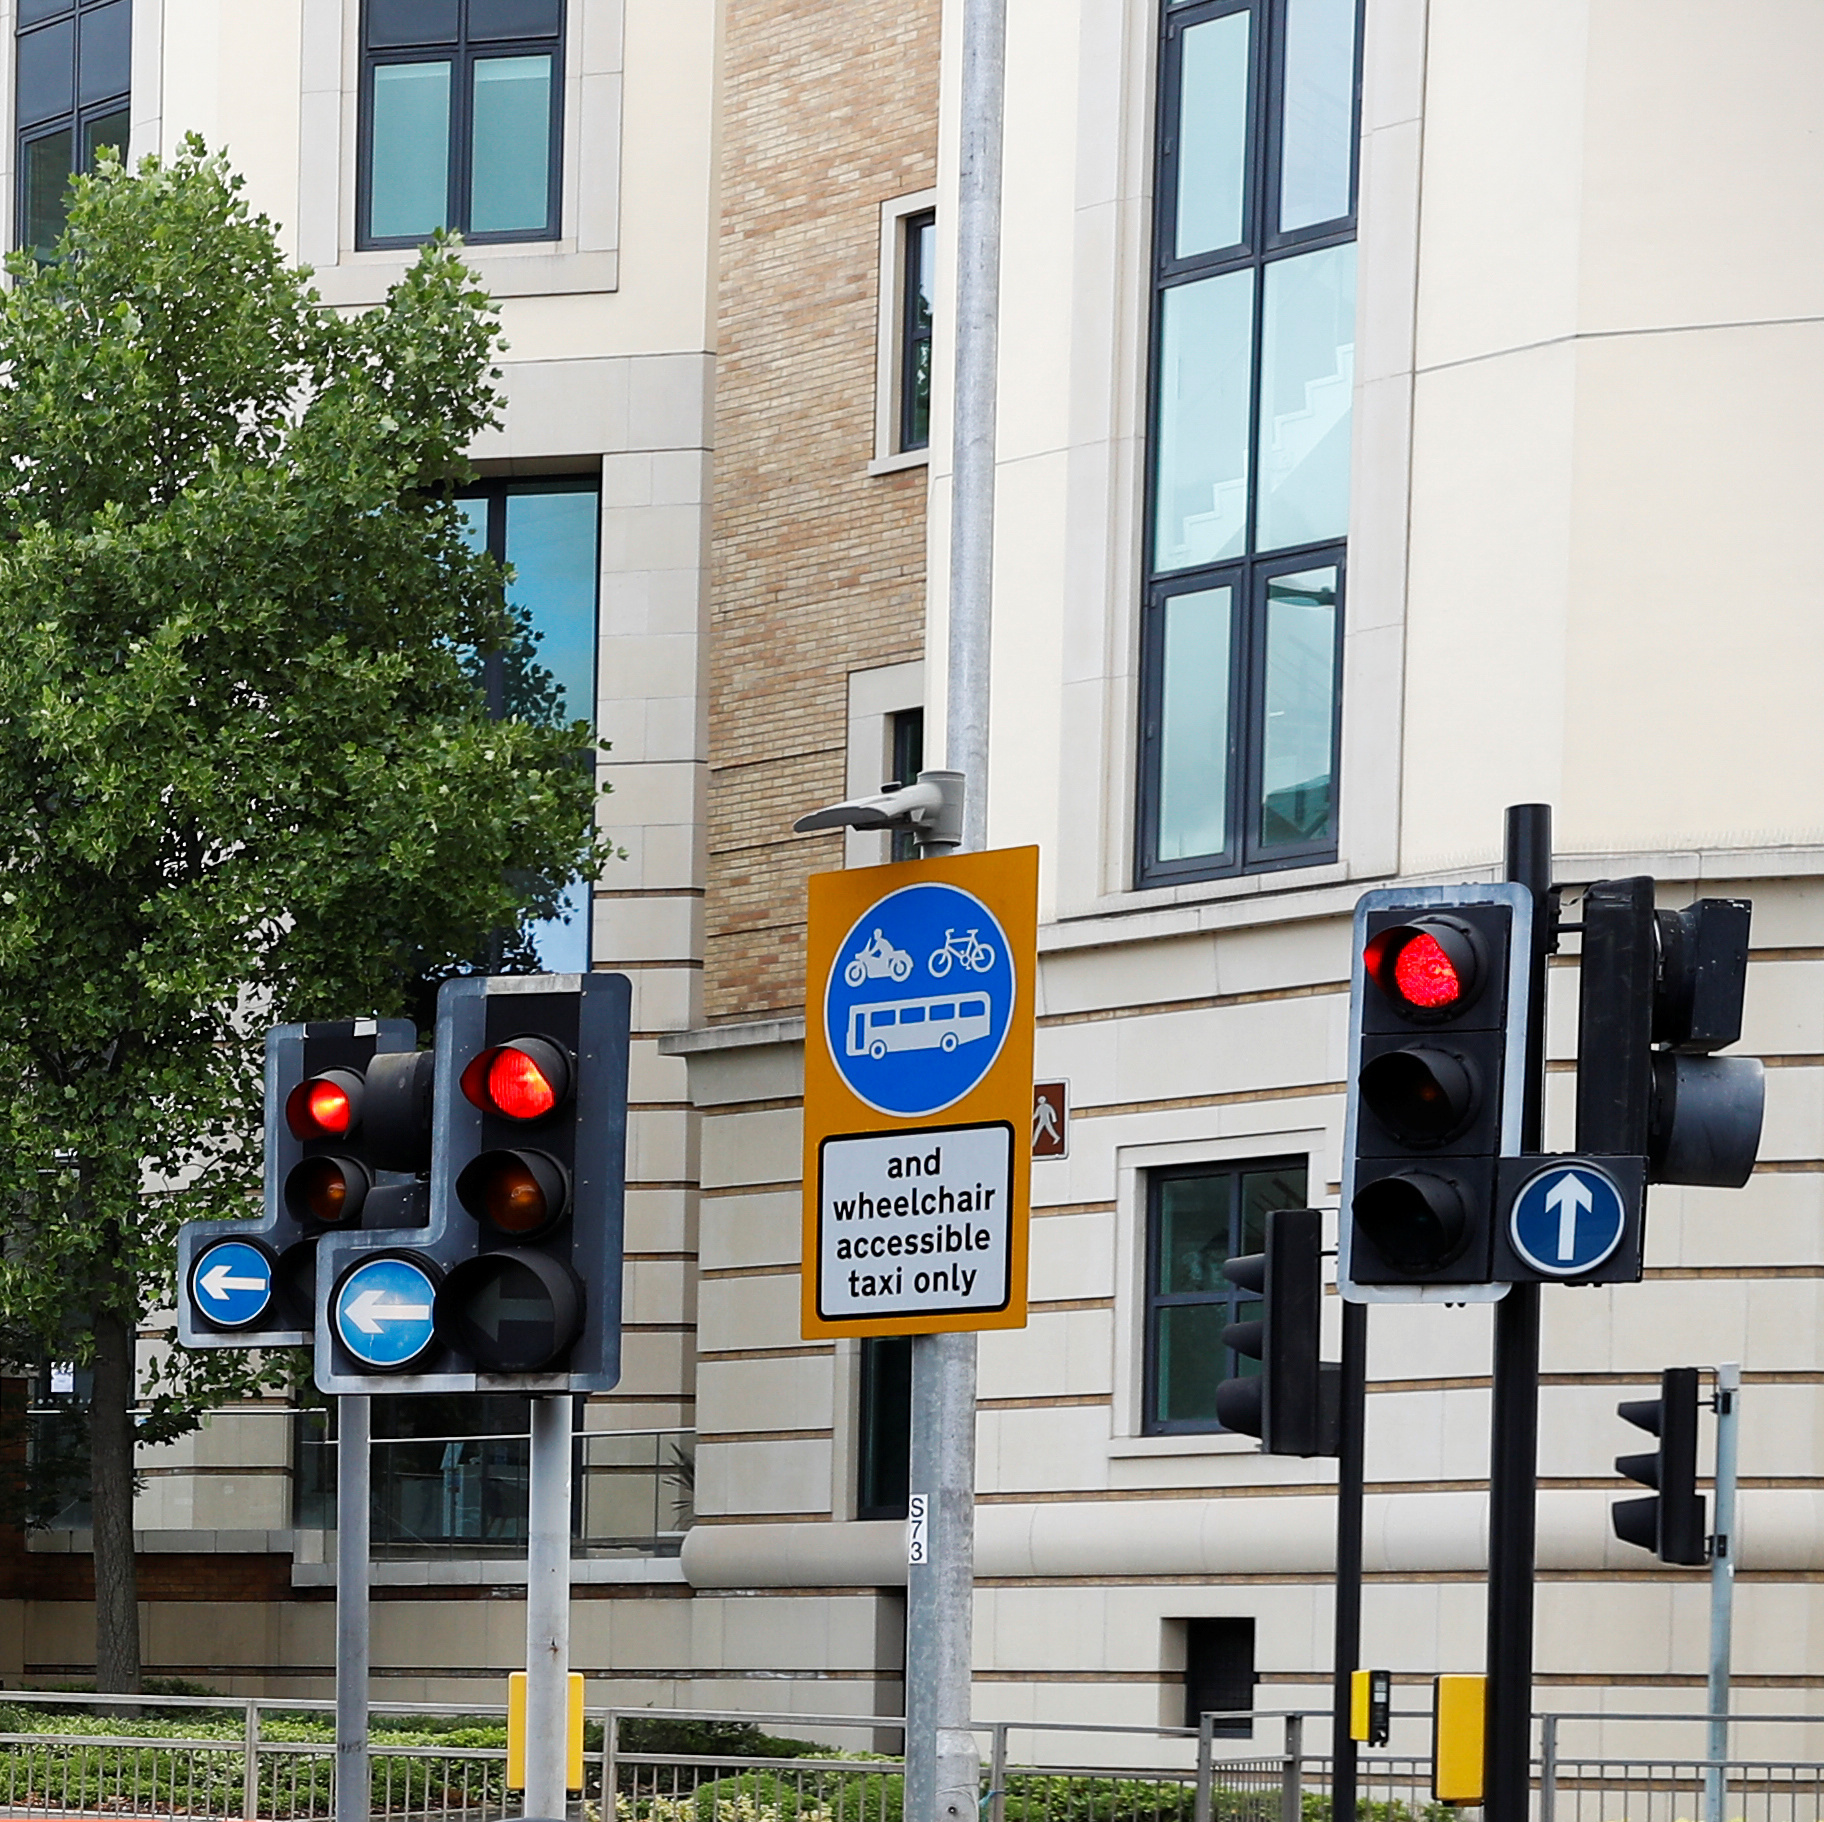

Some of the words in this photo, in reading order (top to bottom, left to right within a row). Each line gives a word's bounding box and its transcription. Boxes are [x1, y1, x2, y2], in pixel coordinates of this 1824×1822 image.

[887, 1147, 941, 1180] and
[833, 1183, 997, 1222] wheelchair
[836, 1222, 991, 1260] accessible
[848, 1266, 903, 1298] taxi
[913, 1262, 978, 1298] only
